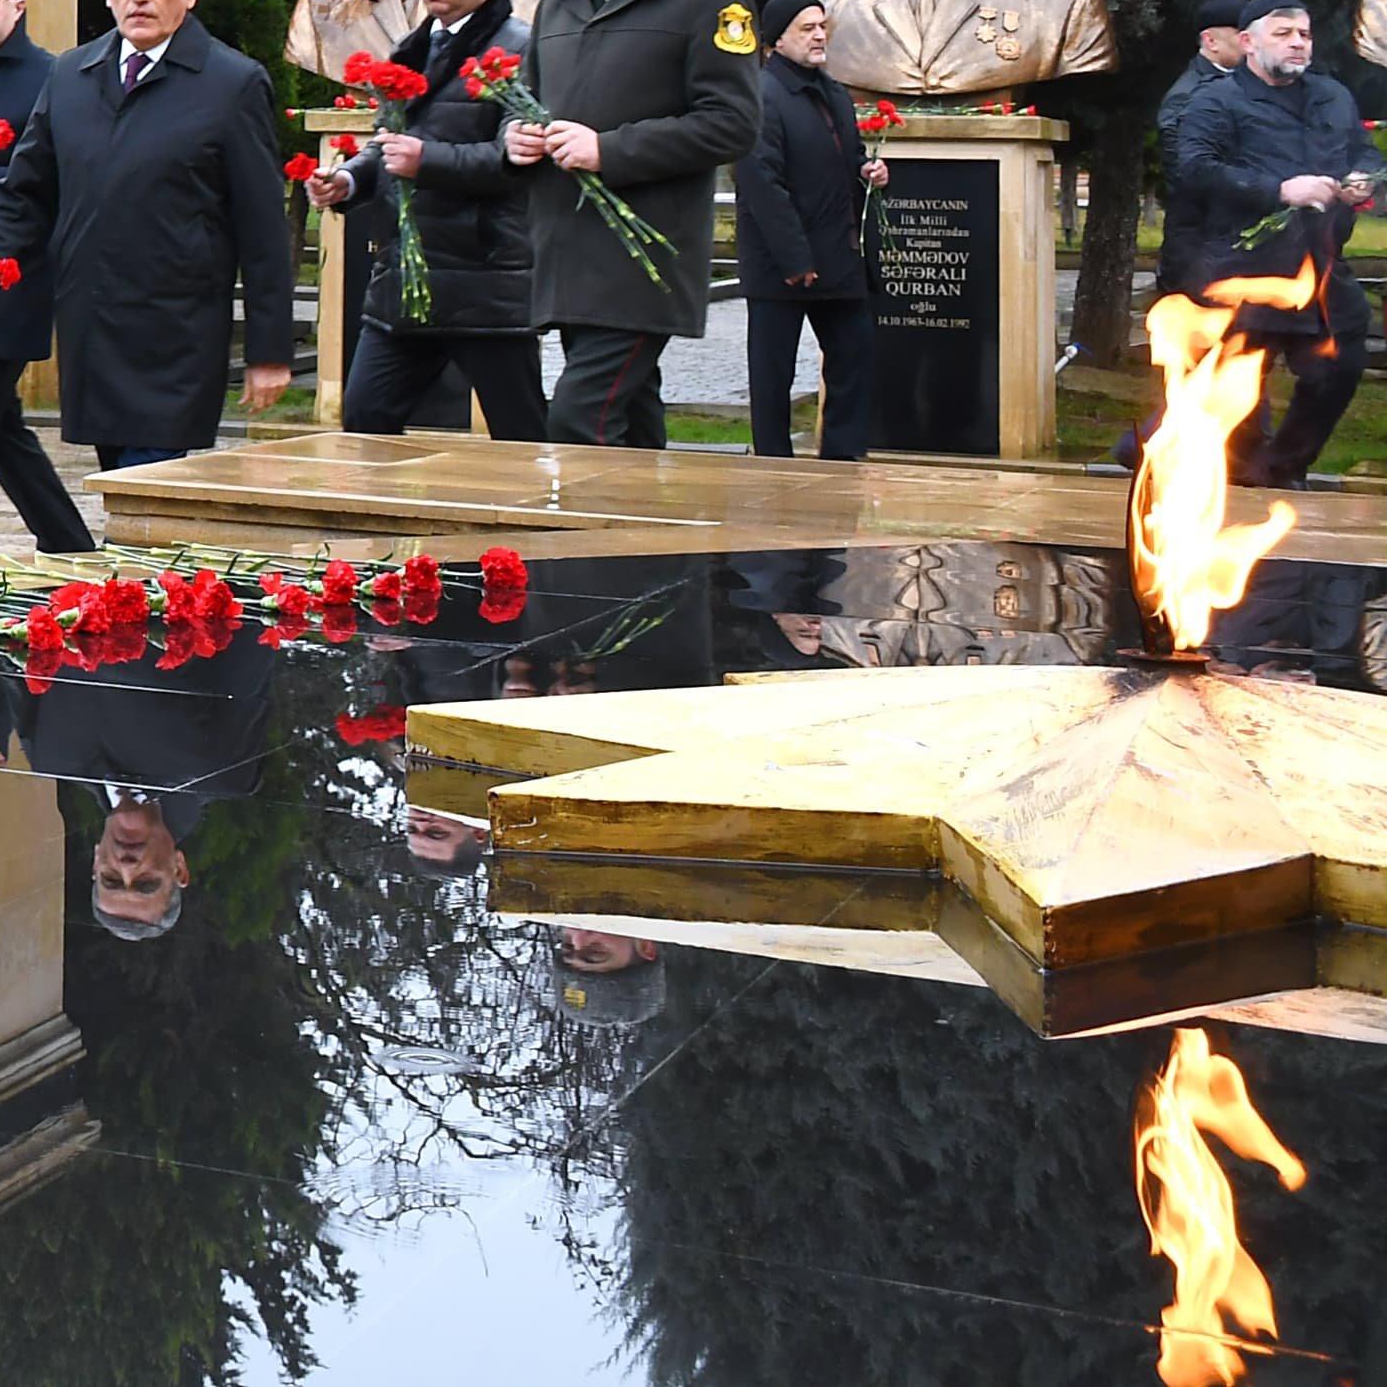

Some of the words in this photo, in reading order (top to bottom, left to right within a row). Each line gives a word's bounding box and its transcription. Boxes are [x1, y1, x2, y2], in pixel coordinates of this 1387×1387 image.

[919, 215, 948, 227] Milli
[878, 250, 970, 264] MƏMMƏDOV
[880, 265, 967, 281] SƏFƏRALI
[885, 281, 962, 297] QURBAN
[909, 301, 937, 314] oğlu
